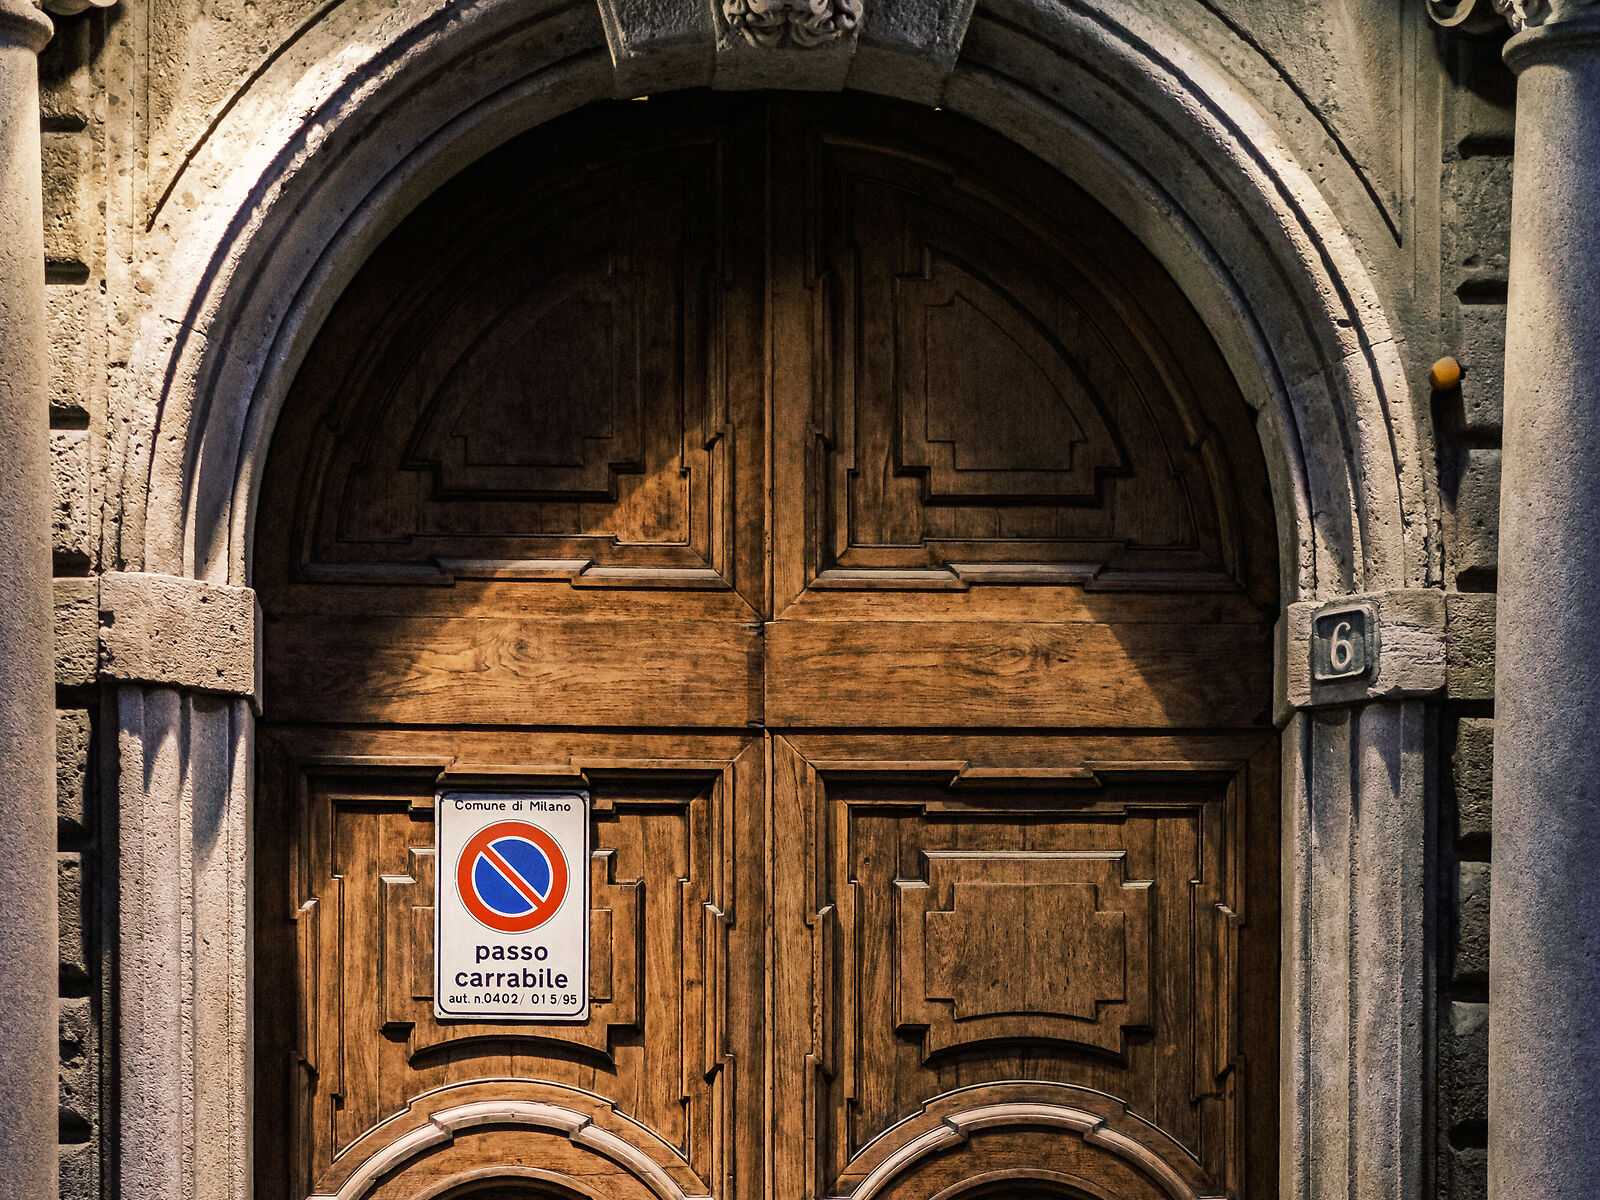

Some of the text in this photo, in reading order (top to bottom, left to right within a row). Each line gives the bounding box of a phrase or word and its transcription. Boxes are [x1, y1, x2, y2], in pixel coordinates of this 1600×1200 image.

[1330, 621, 1353, 672] 6
[454, 800, 571, 812] Comune di Milano
[475, 945, 549, 964] passo
[454, 968, 569, 989] carrabile
[448, 993, 471, 1004] aut.
